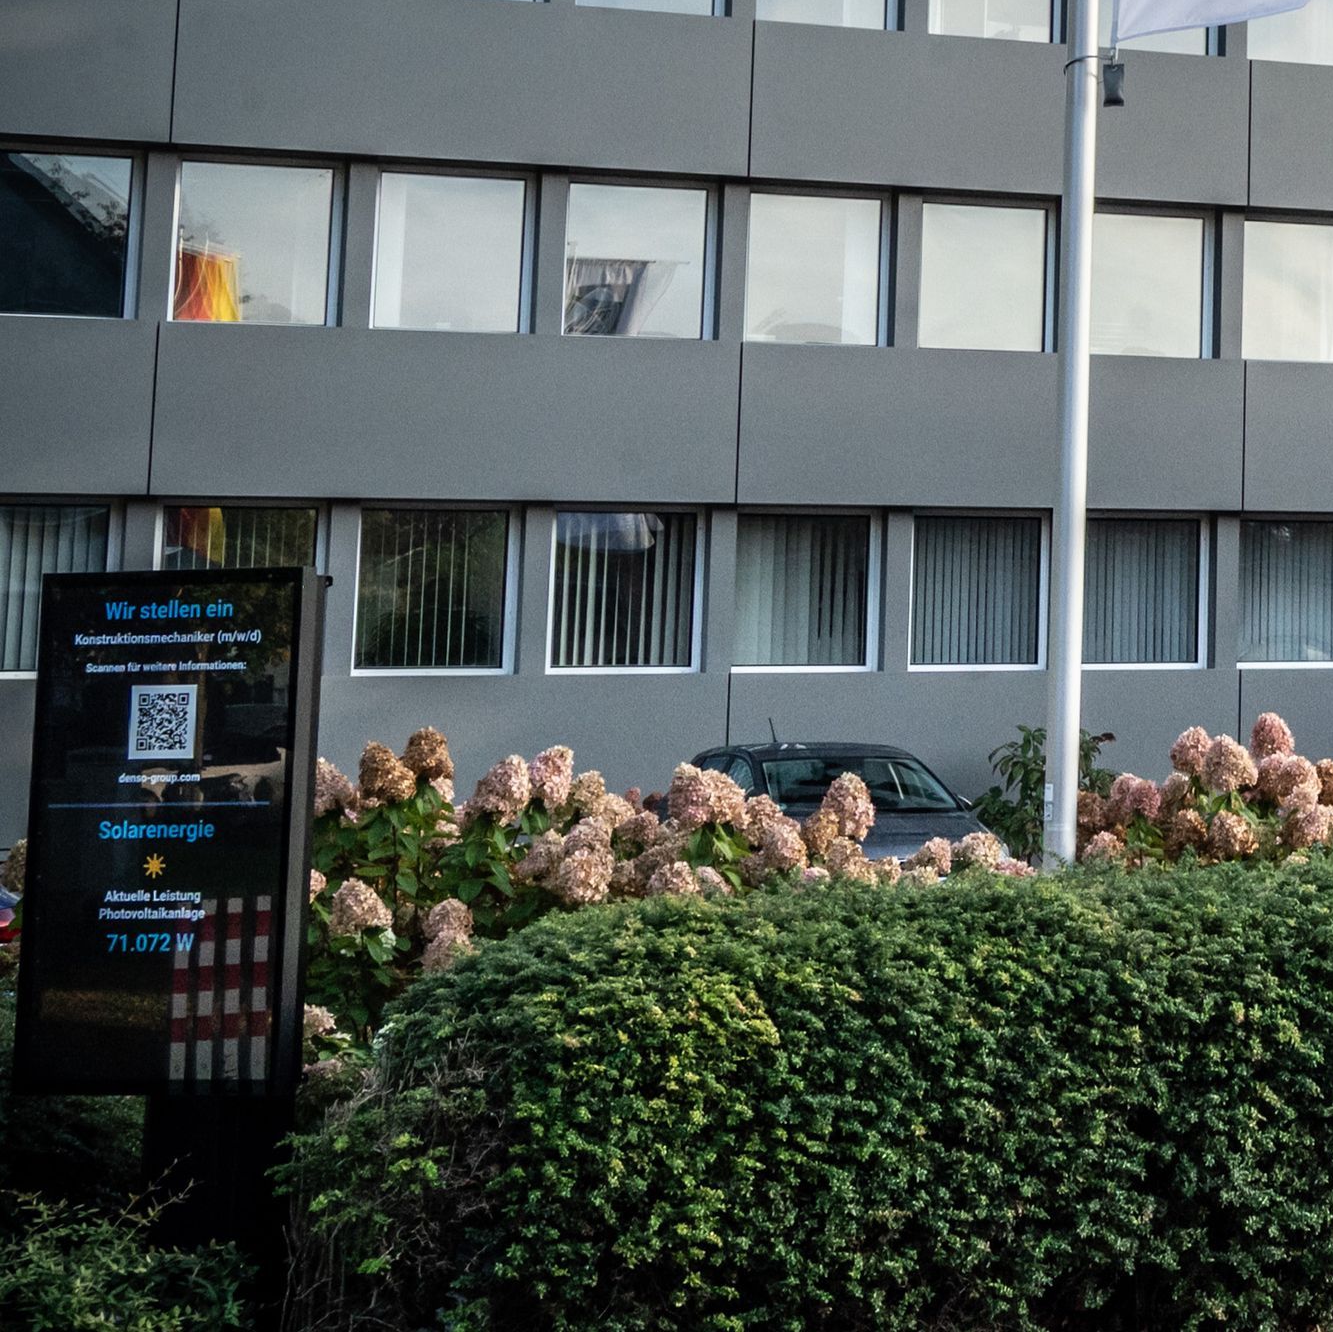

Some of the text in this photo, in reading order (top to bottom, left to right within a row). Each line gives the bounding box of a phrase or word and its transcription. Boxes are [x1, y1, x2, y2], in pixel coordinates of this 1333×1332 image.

[105, 599, 233, 620] Wir stellen ein
[74, 629, 262, 645] Konstruktionsmechaniker (m/w/d)
[85, 660, 247, 673] Scannen für weitere Informationen:
[118, 773, 201, 785] denso-group.com
[98, 820, 215, 843] Solarenergie
[104, 890, 201, 904] Aktuelle Leistung
[98, 907, 206, 922] Photovoltaikanlage
[106, 932, 195, 952] 71.072 W
